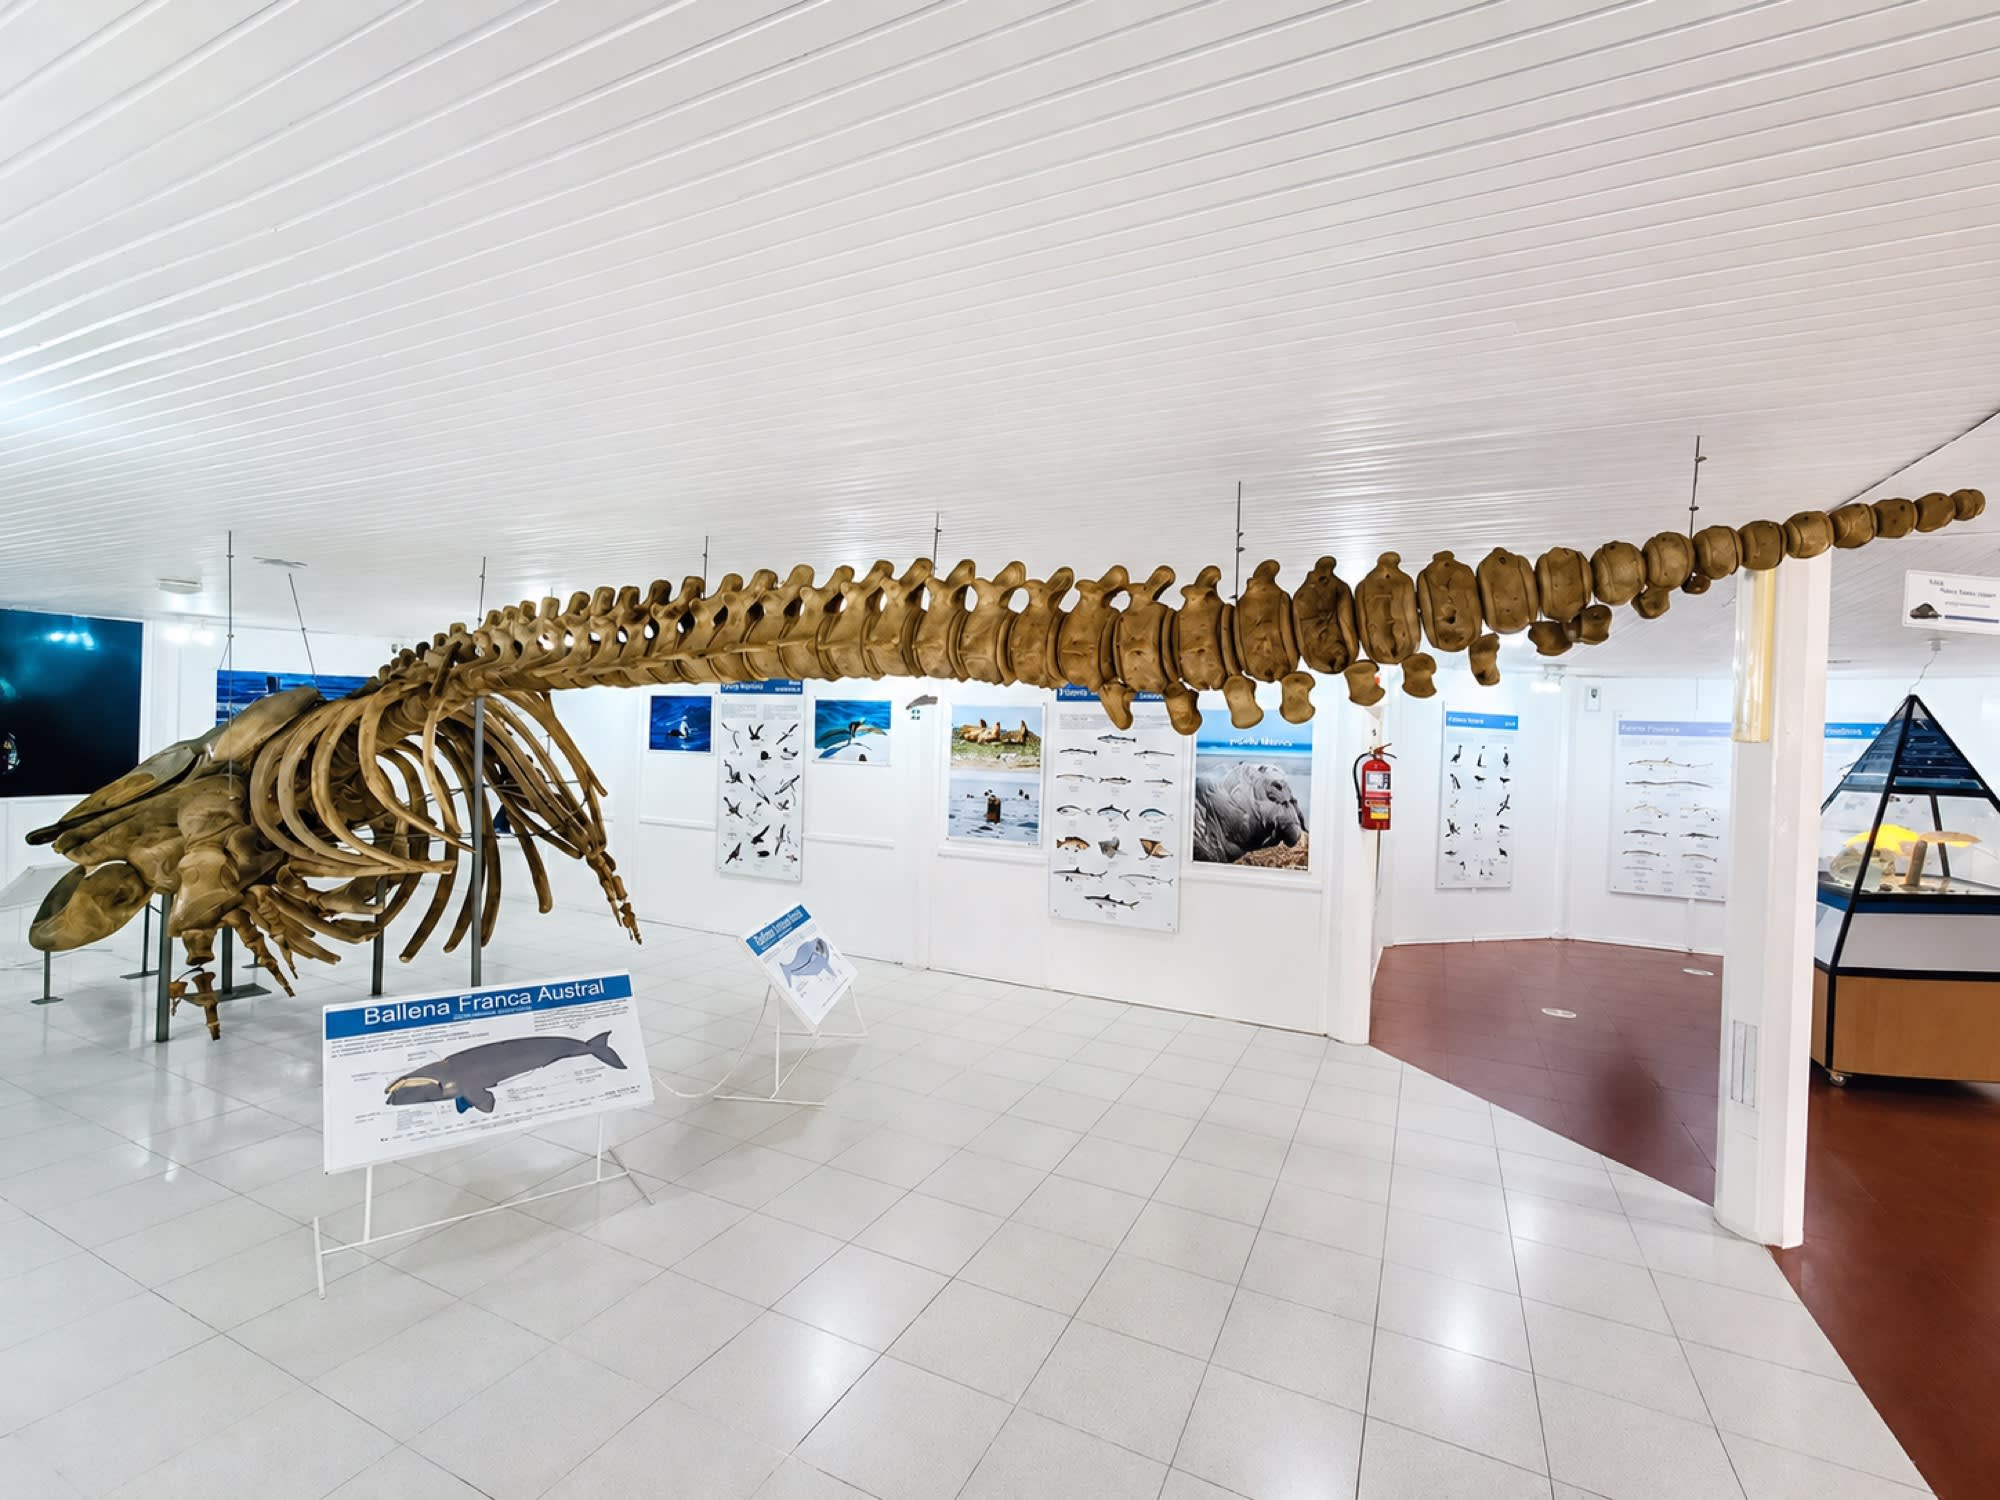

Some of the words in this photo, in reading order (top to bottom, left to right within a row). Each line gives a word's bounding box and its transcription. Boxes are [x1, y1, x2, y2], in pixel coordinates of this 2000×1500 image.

[364, 1003, 450, 1026] Ballena
[459, 993, 531, 1012] Franca
[537, 979, 604, 1002] Austral
